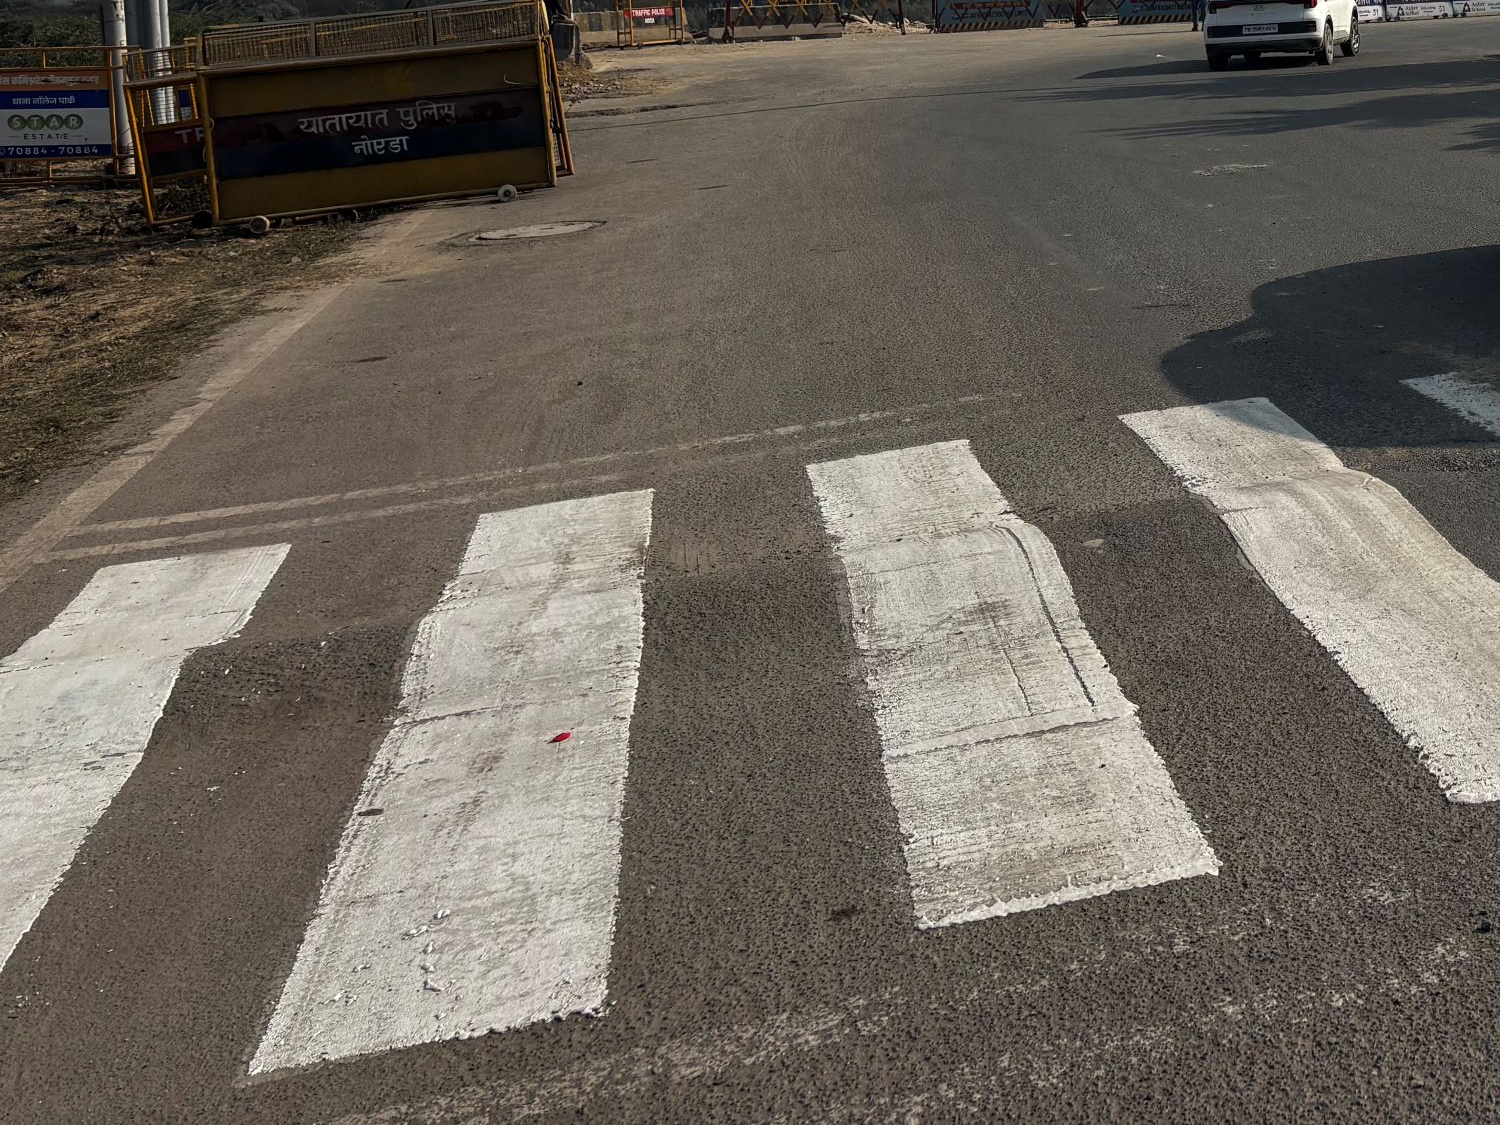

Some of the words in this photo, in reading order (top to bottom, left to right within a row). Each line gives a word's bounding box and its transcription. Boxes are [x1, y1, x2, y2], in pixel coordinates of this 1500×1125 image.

[632, 8, 651, 17] TRAFFIC
[651, 7, 665, 16] POLICE
[13, 97, 31, 105] थाना
[33, 95, 57, 105] नॉलेज
[58, 95, 76, 105] पार्क
[12, 116, 80, 128] STAR
[298, 109, 389, 135] यातायात
[395, 100, 456, 130] पुलिस
[351, 135, 410, 155] नोएडा
